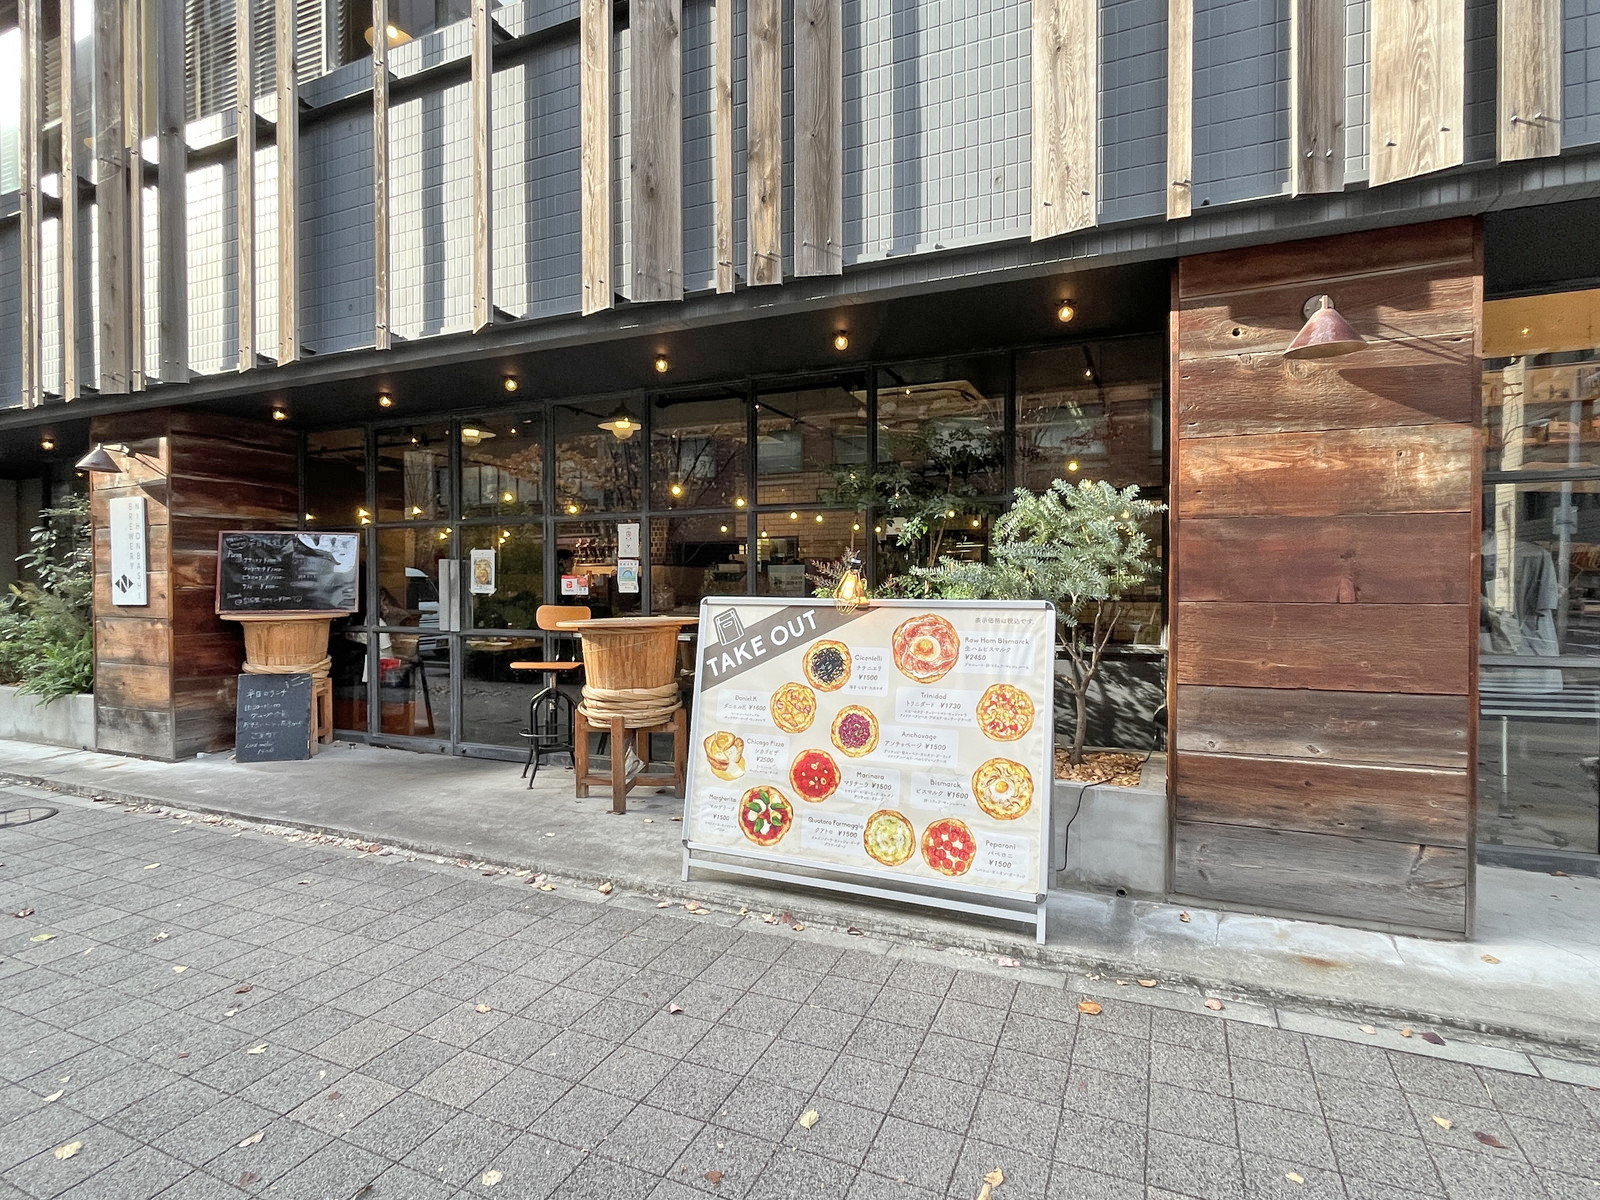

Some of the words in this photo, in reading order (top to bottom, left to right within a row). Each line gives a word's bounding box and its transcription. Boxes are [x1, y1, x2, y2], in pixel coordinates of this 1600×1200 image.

[706, 635, 767, 677] TAKE
[770, 609, 818, 647] OUT
[997, 637, 1030, 645] Bismarck
[920, 691, 947, 700] Trinidad
[940, 702, 962, 710] ¥1730
[901, 730, 937, 741] Anchovage
[746, 737, 770, 747] Chicago
[770, 740, 785, 748] Pizza
[925, 743, 947, 751] ¥1500
[856, 771, 885, 780] Marinara
[871, 782, 892, 790] ¥1500
[930, 778, 961, 788] Bismarck
[947, 791, 969, 799] ¥1600
[713, 813, 730, 821] ¥1500
[838, 830, 858, 839] ¥1500
[985, 839, 1016, 850] Peparoni
[989, 859, 1012, 869] ¥1500
